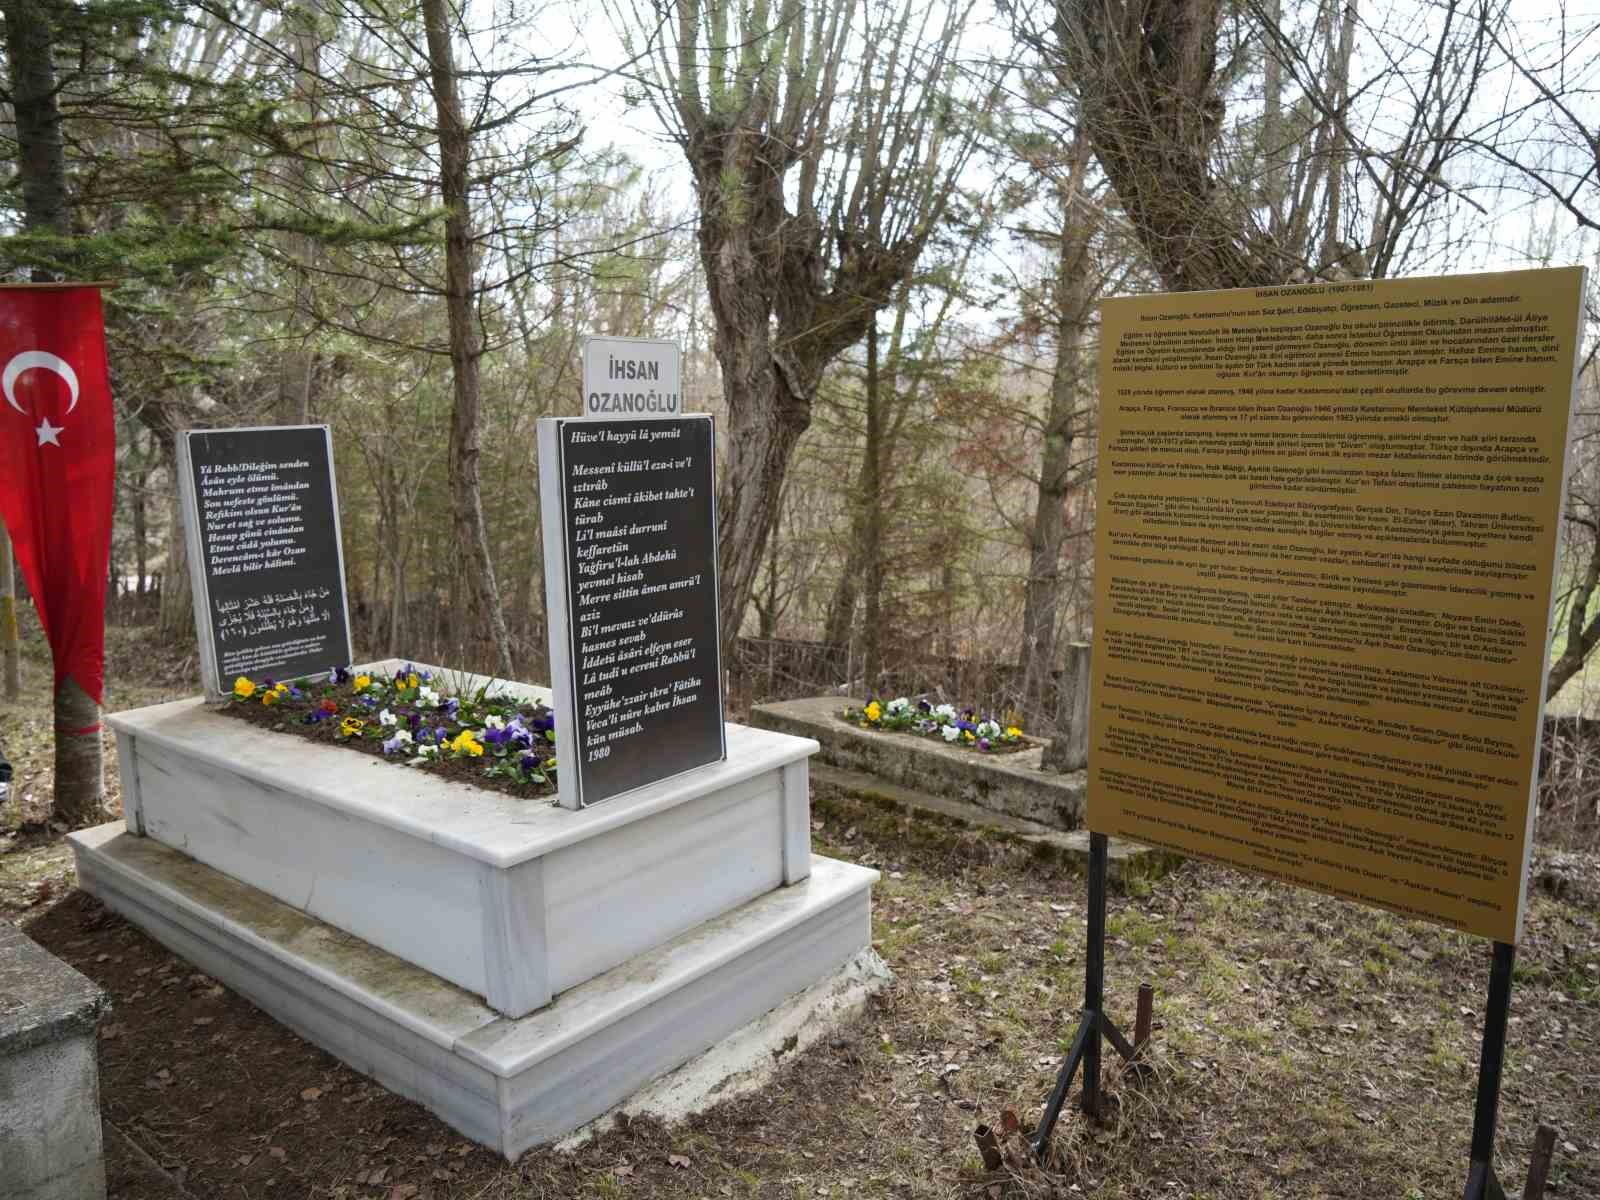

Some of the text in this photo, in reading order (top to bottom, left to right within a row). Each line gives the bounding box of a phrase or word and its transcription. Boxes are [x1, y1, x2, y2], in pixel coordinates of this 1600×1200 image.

[608, 354, 659, 381] İHSAN
[588, 389, 677, 413] OZANOĞLU
[571, 431, 605, 443] Hüve'l
[203, 488, 244, 496] Mahrum
[575, 512, 603, 525] türab
[207, 521, 226, 530] Nur
[210, 545, 234, 553] Etme
[577, 542, 628, 560] keffaretün
[577, 569, 644, 594] yevmel hisab
[579, 594, 611, 606] Merre
[580, 609, 600, 622] aziz
[619, 630, 646, 645] sevab
[673, 638, 692, 648] eser
[583, 672, 596, 685] Lâ
[644, 701, 670, 715] kabre
[672, 694, 697, 707] İhsan
[588, 746, 610, 762] 1980
